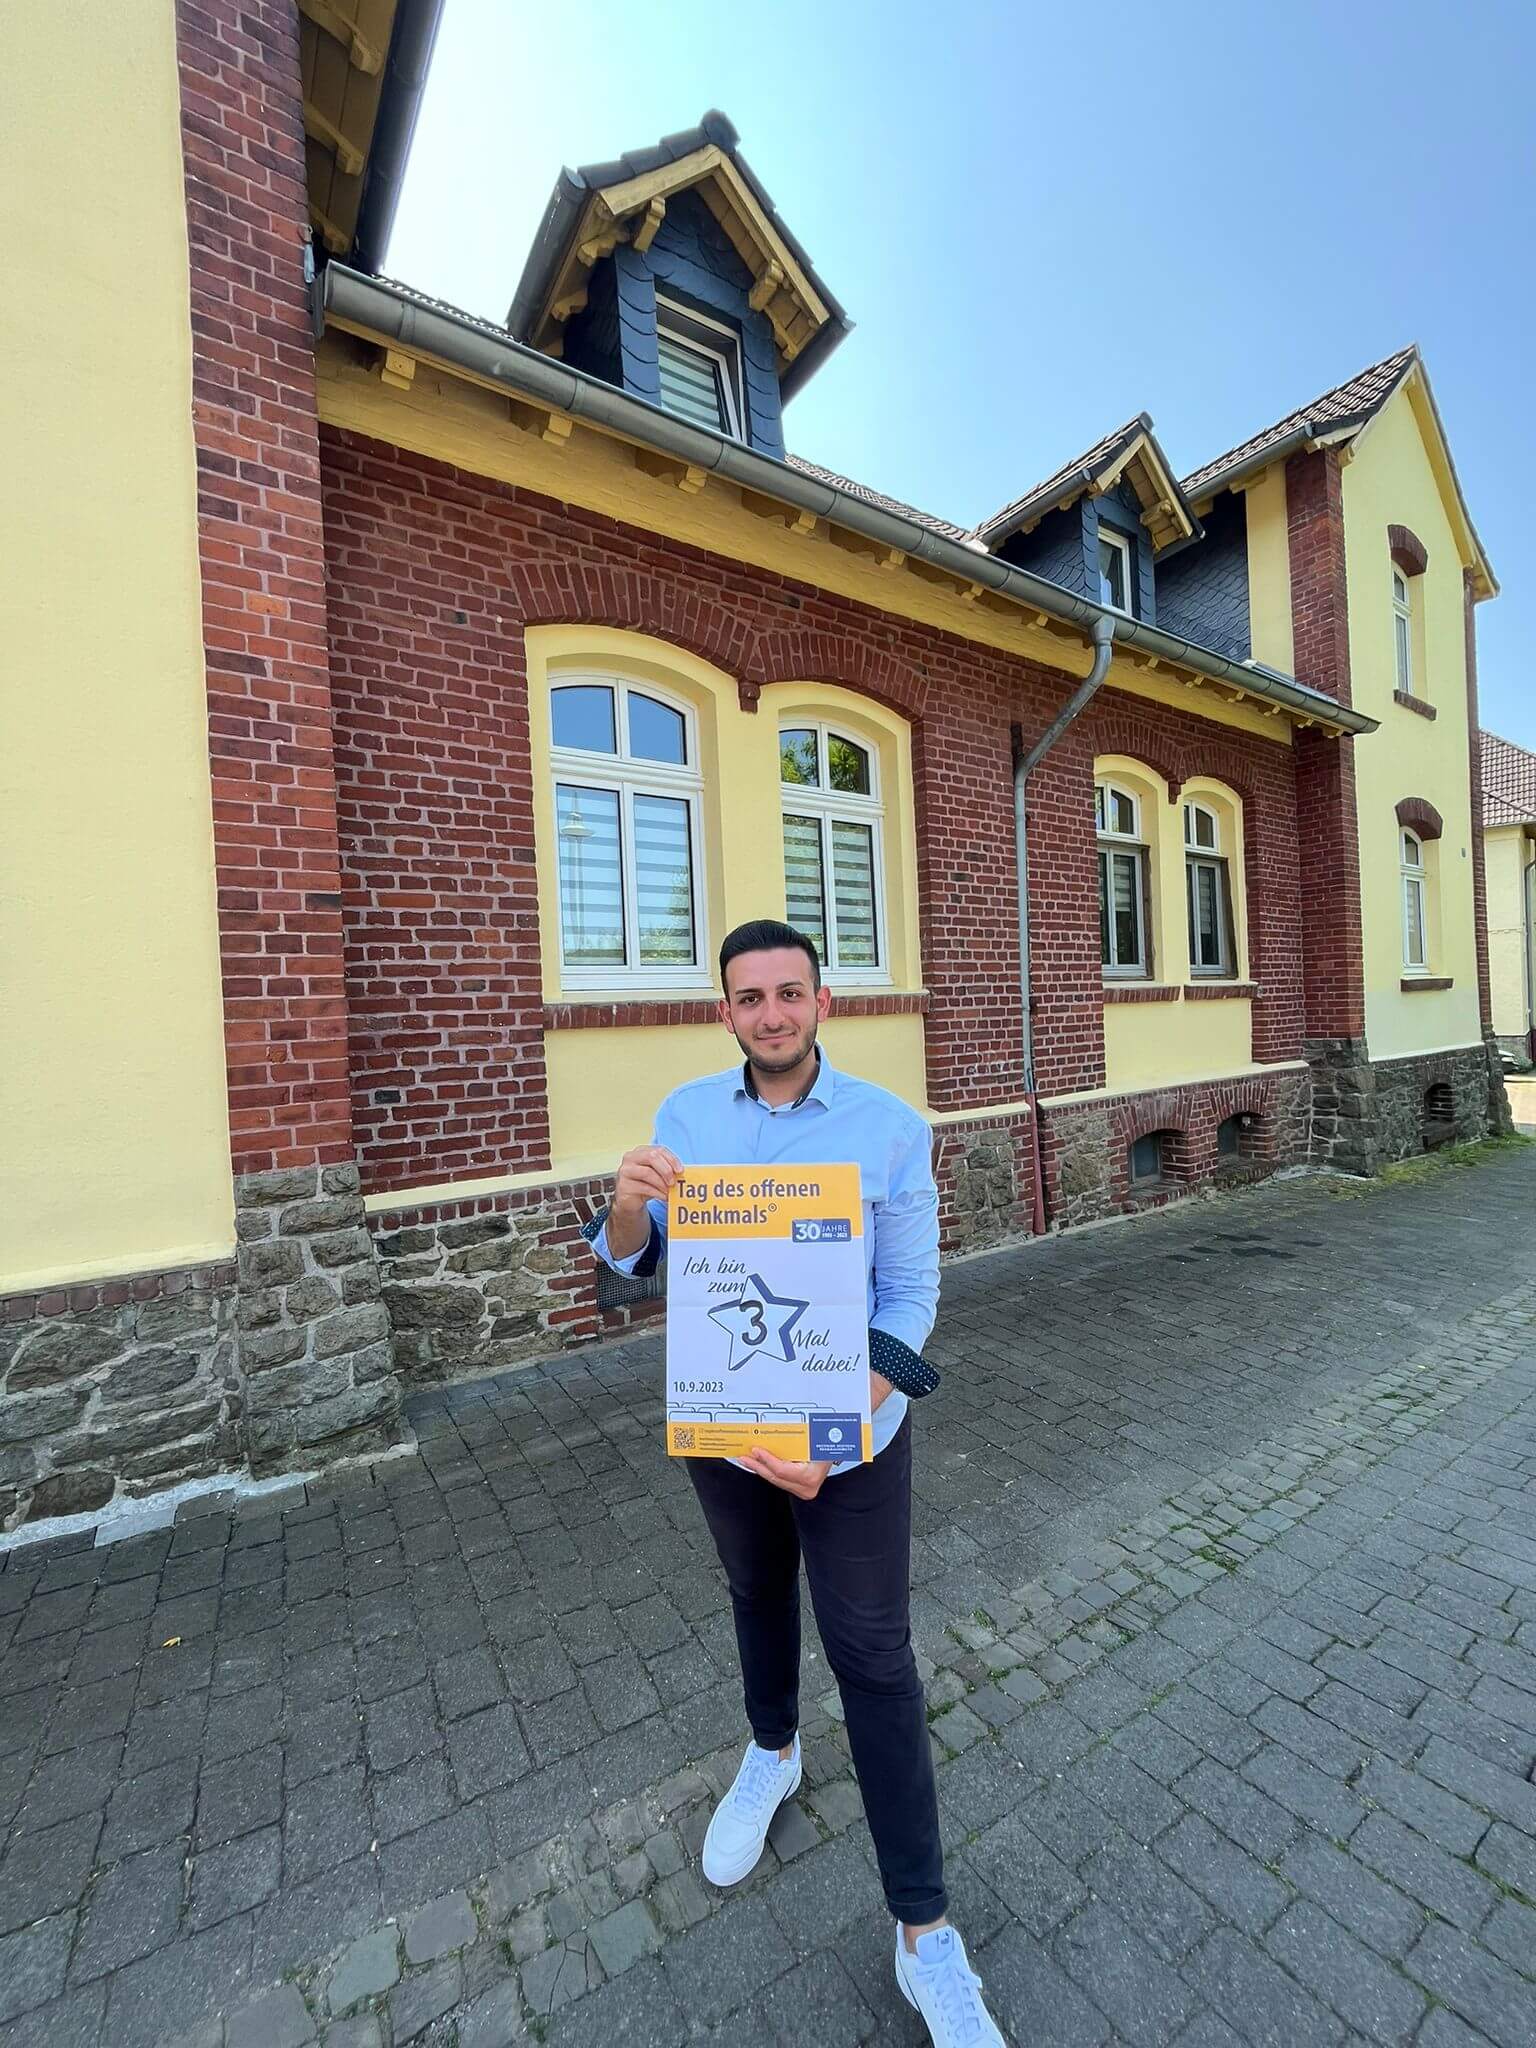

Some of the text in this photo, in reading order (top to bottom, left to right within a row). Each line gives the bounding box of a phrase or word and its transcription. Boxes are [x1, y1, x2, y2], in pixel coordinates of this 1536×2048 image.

[678, 1179, 821, 1202] Tag des offenen
[795, 1223, 820, 1240] 30
[822, 1224, 848, 1232] JAHRE
[683, 1256, 746, 1276] Ich bin
[707, 1280, 747, 1293] zum
[739, 1299, 768, 1346] 3
[791, 1329, 831, 1349] Mal
[801, 1353, 861, 1372] dabei!
[673, 1381, 724, 1393] 10.9.2023
